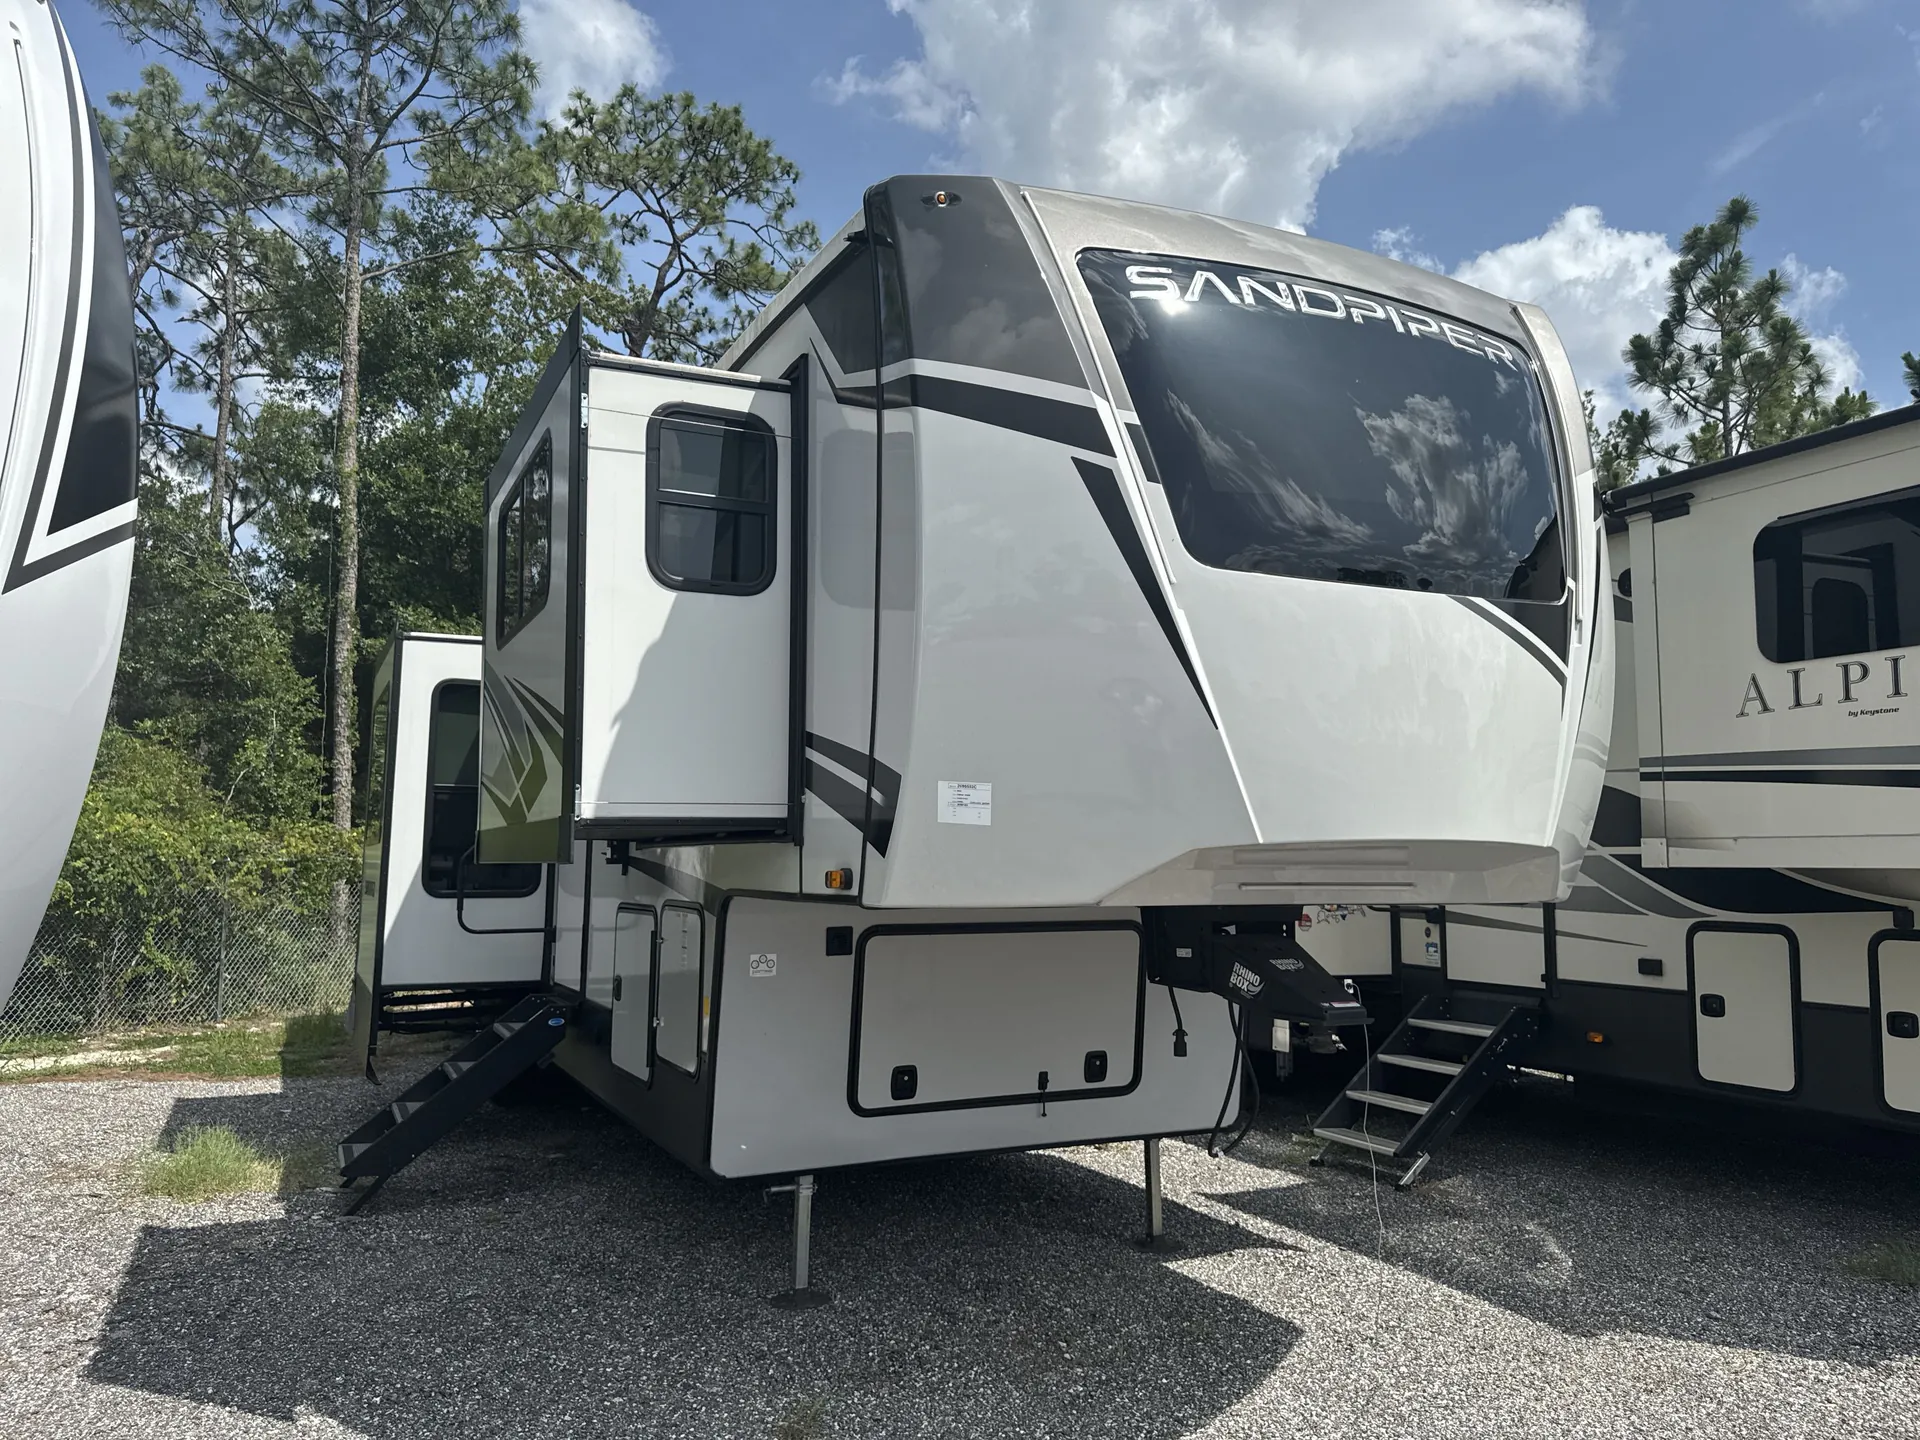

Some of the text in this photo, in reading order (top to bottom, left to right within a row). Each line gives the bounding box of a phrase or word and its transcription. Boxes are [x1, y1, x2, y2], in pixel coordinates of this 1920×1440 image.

[1124, 265, 1518, 371] SANDPIPER
[1736, 654, 1908, 718] ALPI
[1848, 707, 1900, 718] by Keystone
[1230, 971, 1250, 992] BOX
[1233, 961, 1261, 986] RHINO
